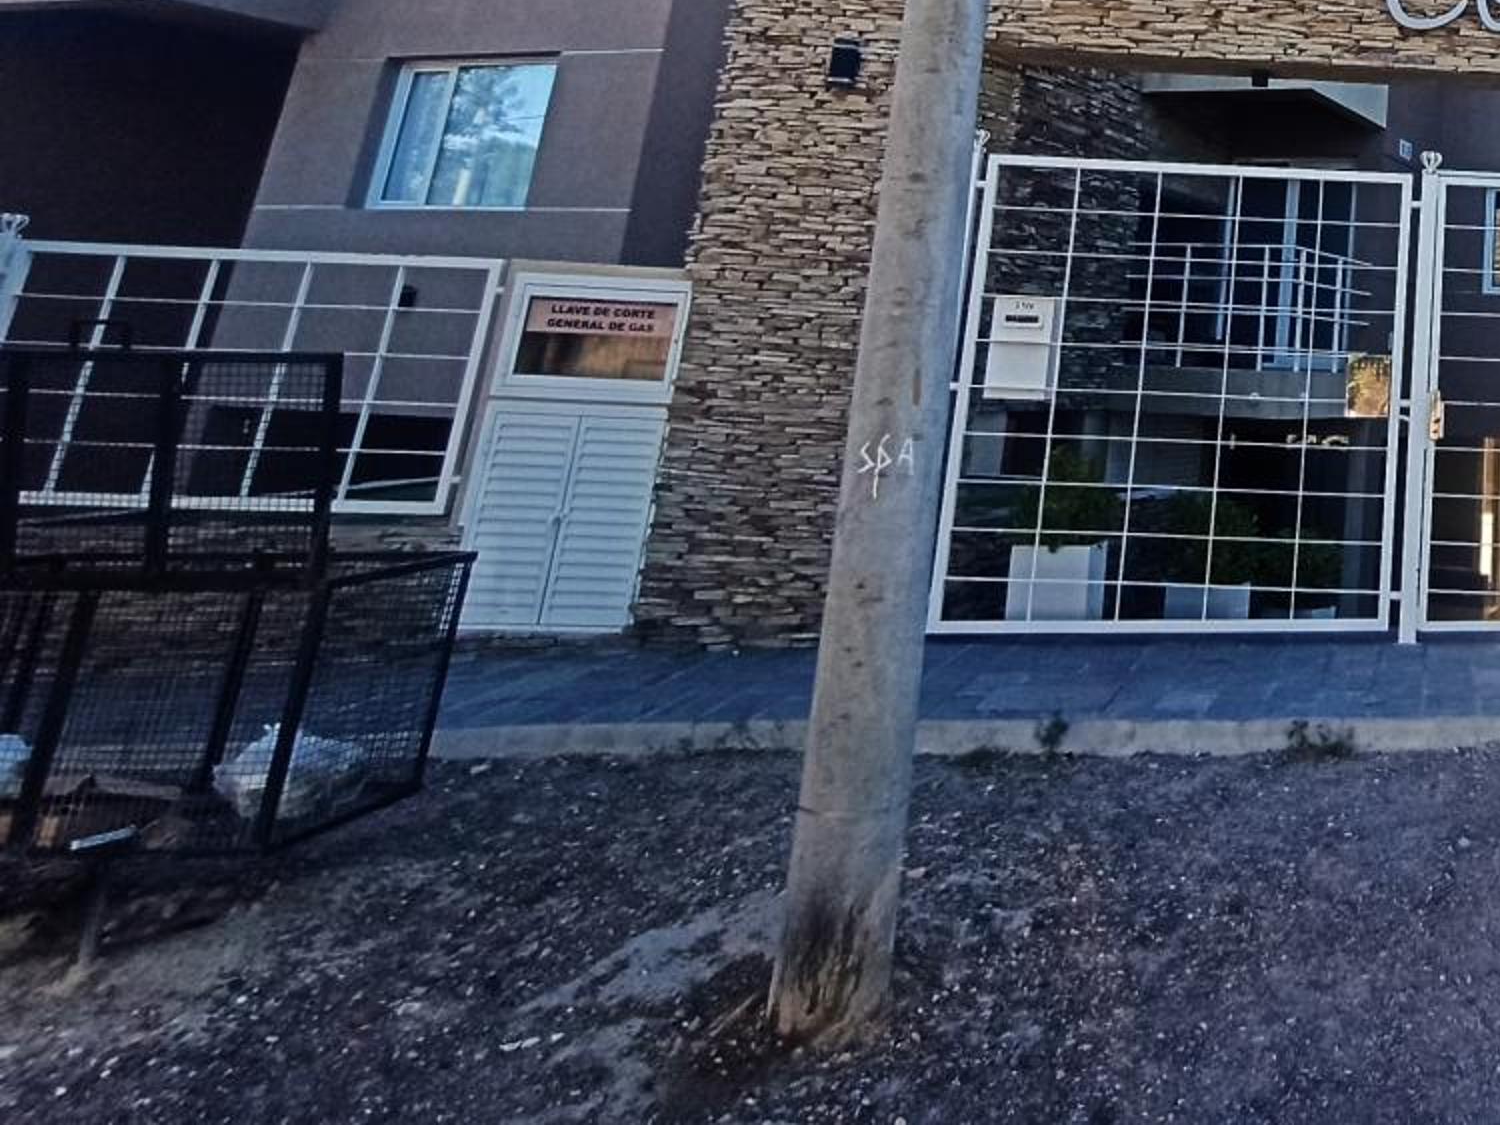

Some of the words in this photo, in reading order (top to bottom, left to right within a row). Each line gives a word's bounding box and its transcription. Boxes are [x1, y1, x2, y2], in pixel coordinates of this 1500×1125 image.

[551, 303, 591, 317] LLAVE
[593, 306, 610, 318] DE
[613, 307, 656, 320] CORTE
[547, 317, 605, 331] GENERAL
[607, 320, 626, 332] DE
[628, 321, 655, 333] GAS
